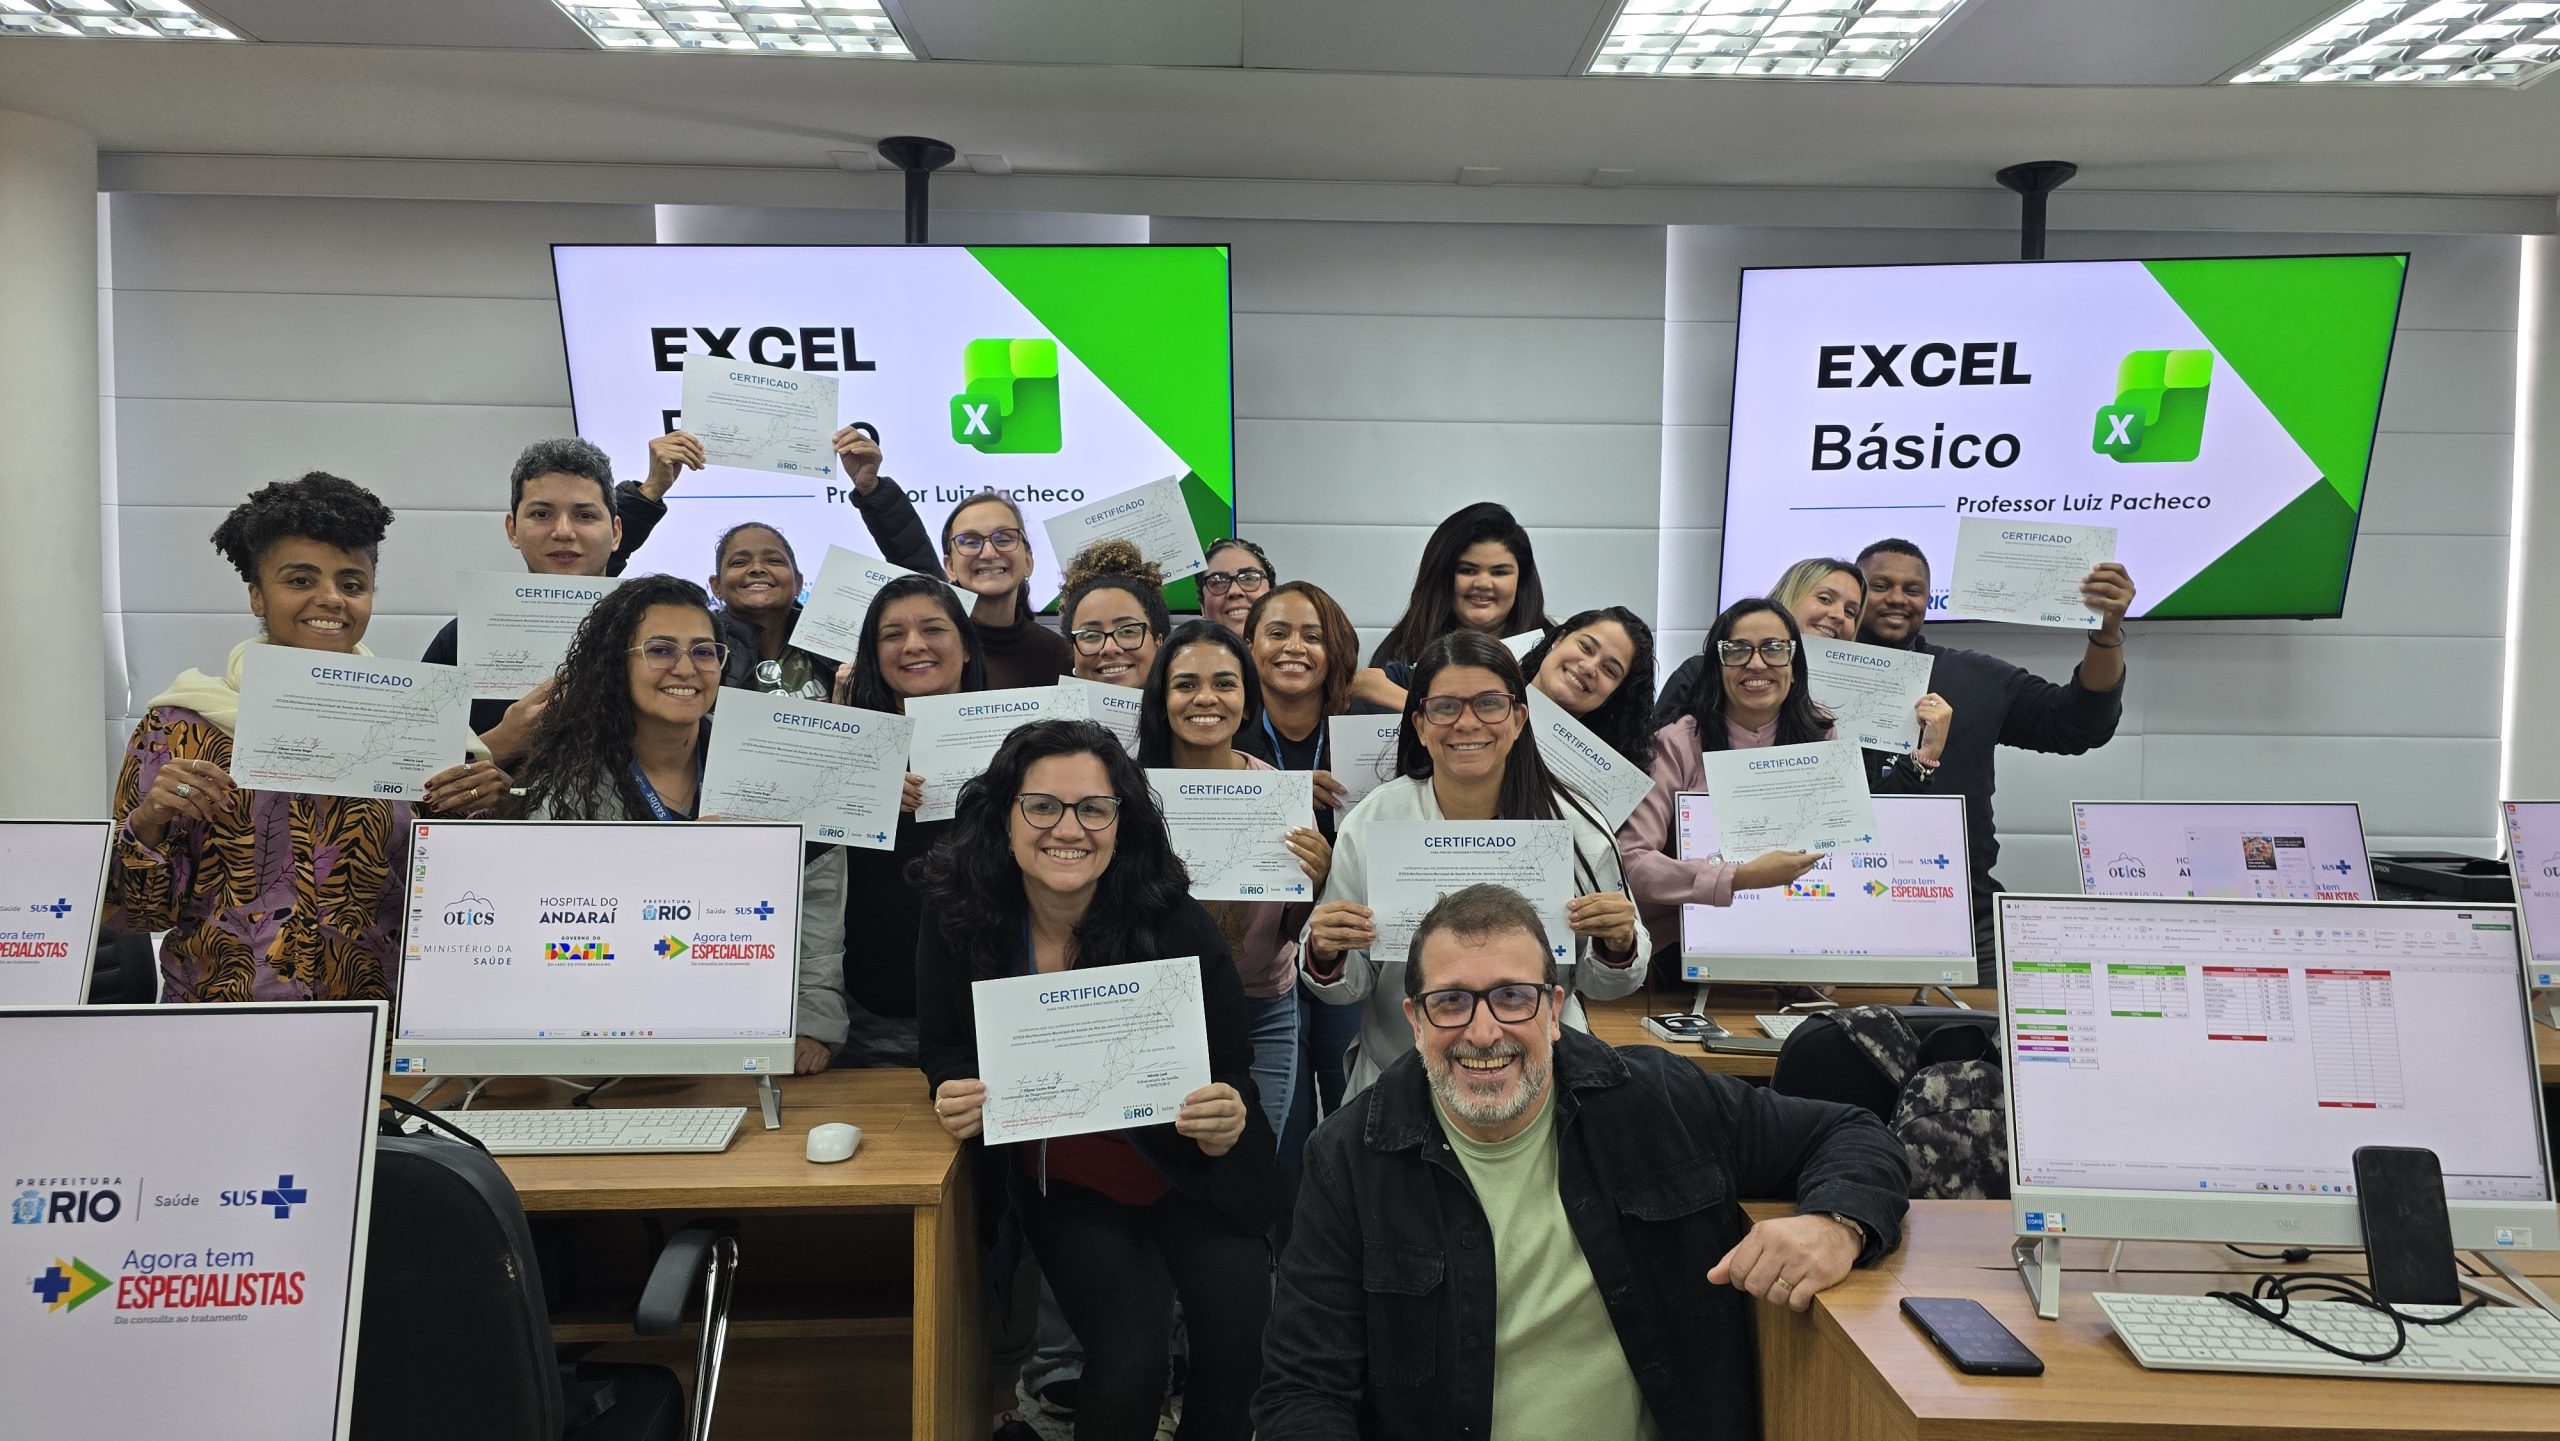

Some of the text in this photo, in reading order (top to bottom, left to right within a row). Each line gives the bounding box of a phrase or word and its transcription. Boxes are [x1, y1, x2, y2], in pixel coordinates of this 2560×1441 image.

[651, 326, 876, 371] EXCEL
[1817, 342, 2031, 388] EXCEL
[730, 372, 798, 391] CERTIFICADO
[1812, 422, 2020, 471] Básico
[1957, 493, 2211, 513] Professor Luiz Pacheco
[1084, 499, 1145, 526] CERTIFICADO
[2001, 531, 2072, 545] CERTIFICADO
[515, 588, 602, 600] CERTIFICADO
[1825, 650, 1891, 668] CERTIFICADO
[311, 667, 413, 688] CERTIFICADO
[958, 701, 1040, 717] CERTIFICADO
[1102, 697, 1141, 710] CERTIF
[773, 712, 861, 735] CERTIFICADO
[1552, 723, 1613, 772] CERTIFICADO
[1864, 736, 1878, 745] RIO
[1748, 755, 1819, 771] CERTIFICADO
[383, 784, 402, 794] RIO
[1179, 784, 1262, 795] CERTIFICADO
[646, 791, 666, 818] SAÚDE
[828, 828, 844, 838] RIO
[1424, 836, 1516, 848] CERTIFICADO
[1820, 840, 1836, 849] RIO
[1864, 857, 1887, 868] RIO
[2109, 865, 2146, 878] otics
[1892, 877, 1917, 886] Agora
[1248, 886, 1264, 895] RIO
[1892, 886, 1954, 898] ESPECIALISTAS
[30, 904, 49, 912] SUS
[540, 898, 618, 906] HOSPITAL DO
[443, 908, 495, 925] otics
[539, 908, 617, 923] ANDARAÍ
[659, 905, 691, 920] RIO
[735, 907, 752, 915] SUS
[0, 931, 45, 940] ora tem
[693, 932, 752, 944] Agora tem
[424, 944, 512, 953] MINISTÉRIO DA
[545, 943, 615, 960] BRASIL
[691, 944, 775, 959] ESPECIALISTAS
[474, 956, 511, 965] SAÚDE
[1039, 981, 1140, 1004] CERTIFICADO
[1134, 1107, 1153, 1118] RIO
[16, 1176, 122, 1187] PREFEITURA
[48, 1190, 257, 1224] RIO Saúde SUS
[122, 1248, 254, 1274] Agora tem
[116, 1270, 305, 1309] ESPECIALISTAS
[114, 1315, 128, 1324] Da
[130, 1314, 174, 1324] consulta
[191, 1313, 248, 1322] tratamento
